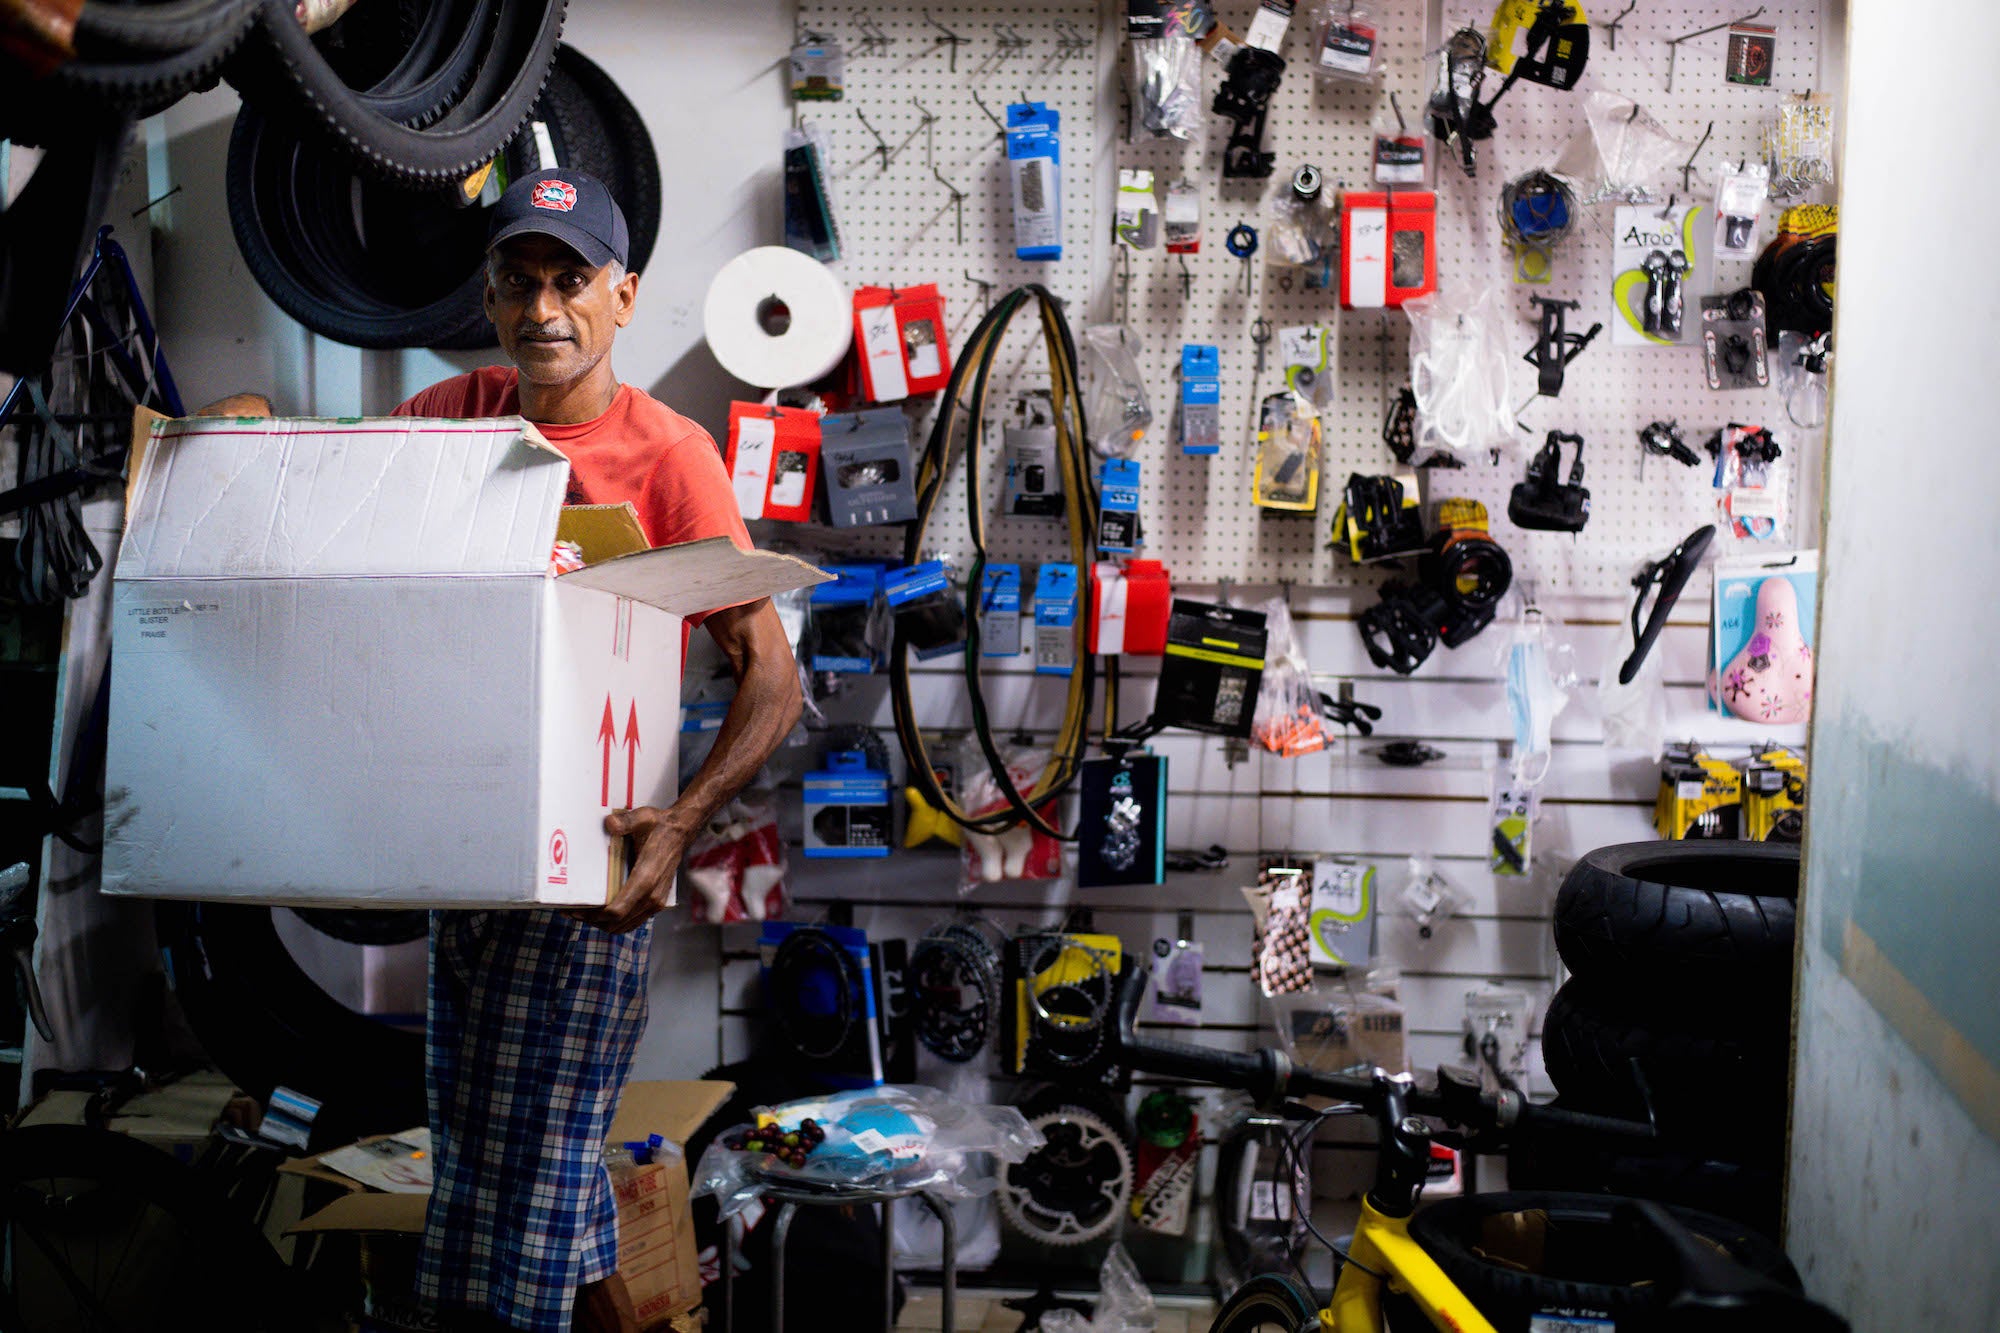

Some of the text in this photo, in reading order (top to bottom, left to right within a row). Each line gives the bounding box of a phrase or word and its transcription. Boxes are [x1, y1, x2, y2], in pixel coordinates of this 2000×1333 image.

[128, 607, 180, 616] LITTLE BOTTLE
[139, 616, 169, 624] BLISTER
